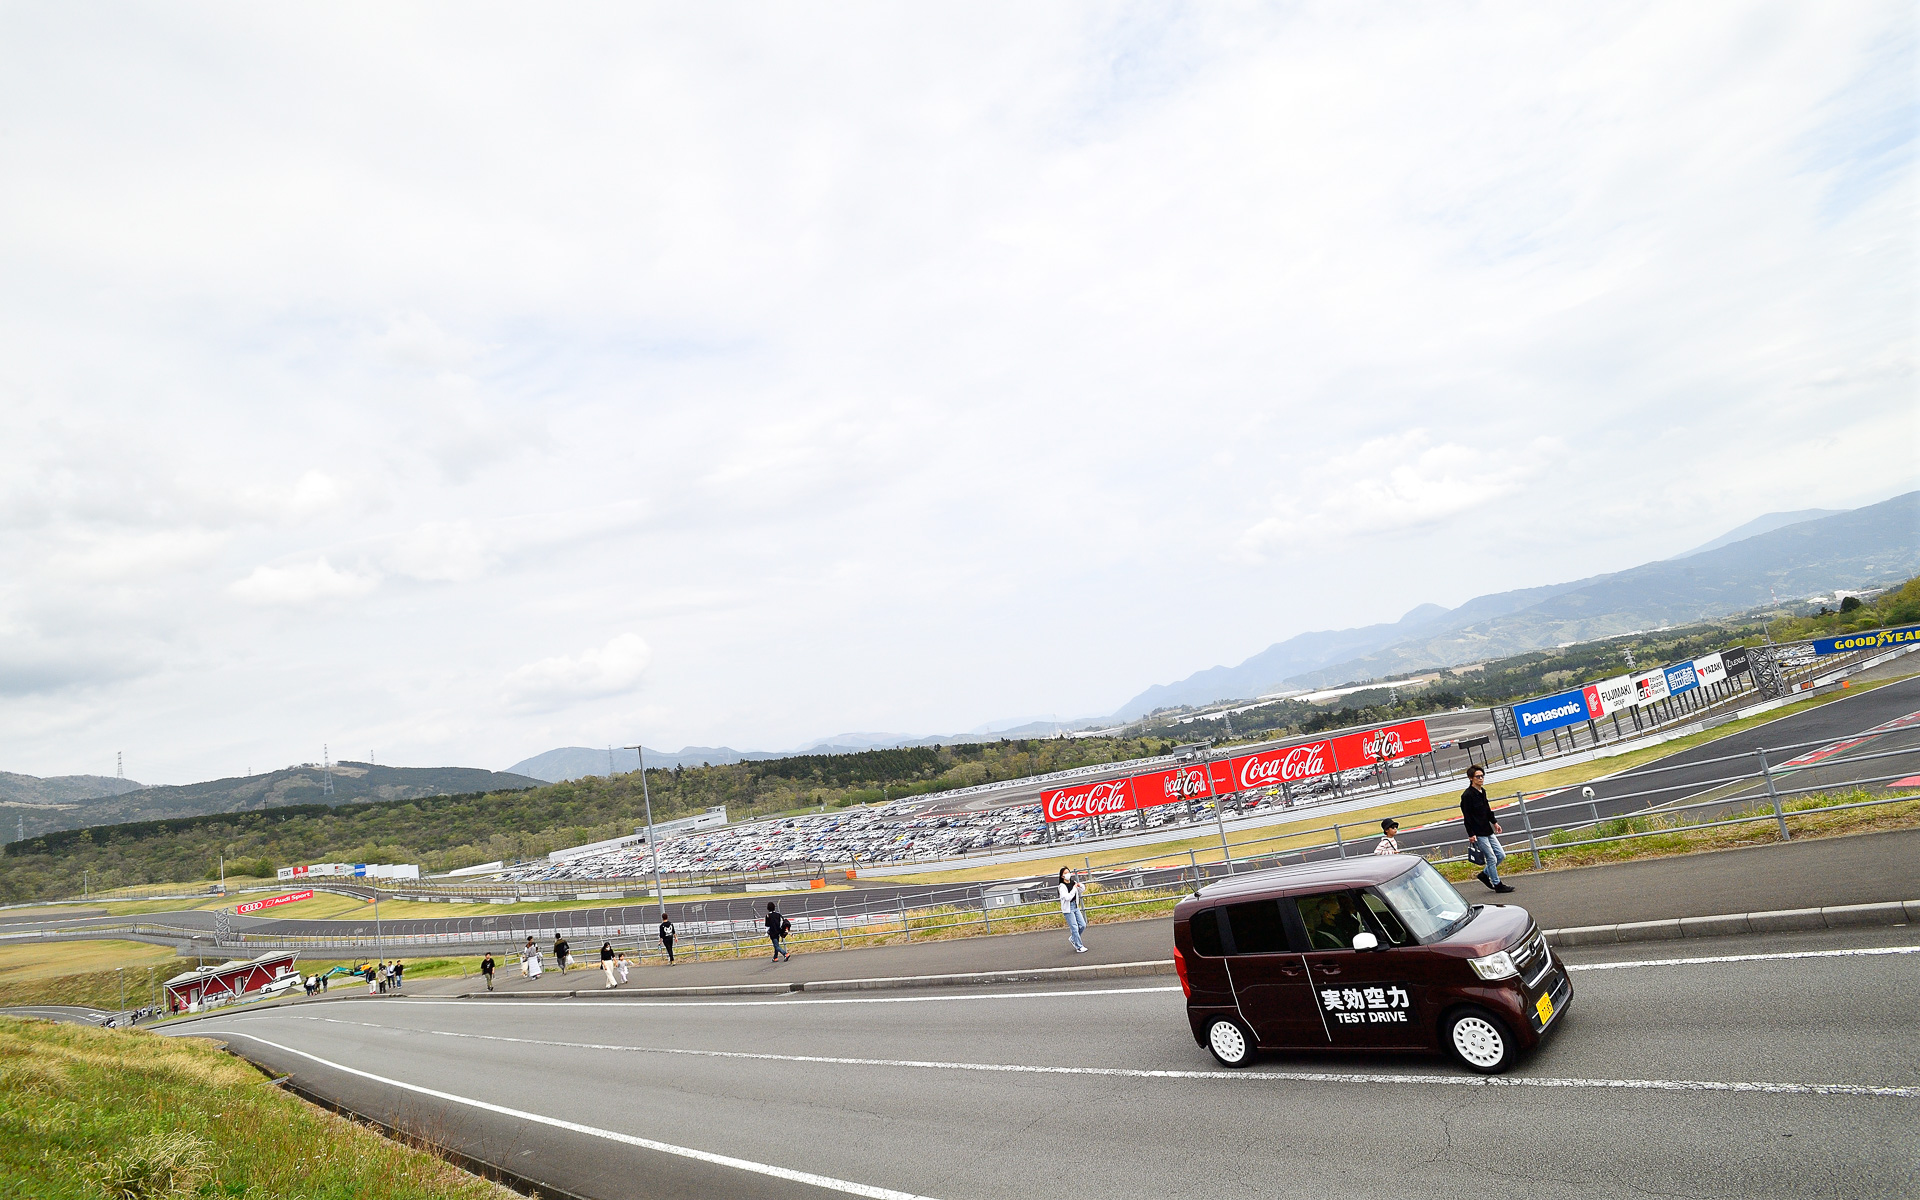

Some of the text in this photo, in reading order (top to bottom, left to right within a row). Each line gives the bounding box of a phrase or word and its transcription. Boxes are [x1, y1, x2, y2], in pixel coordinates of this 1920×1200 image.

[1703, 662, 1723, 675] YAZAKI
[1601, 684, 1632, 703] FUJIMAKI
[1522, 701, 1580, 726] Panasonic
[1363, 731, 1404, 760] Coca-Cola
[1240, 743, 1325, 787] Coca-Cola
[1164, 770, 1207, 798] Coca-Cola
[1048, 781, 1127, 819] Coca-Cola
[274, 892, 311, 904] Audi Sport
[1320, 986, 1410, 1011] 実効空力
[1335, 1011, 1408, 1024] TEST DRIVE
